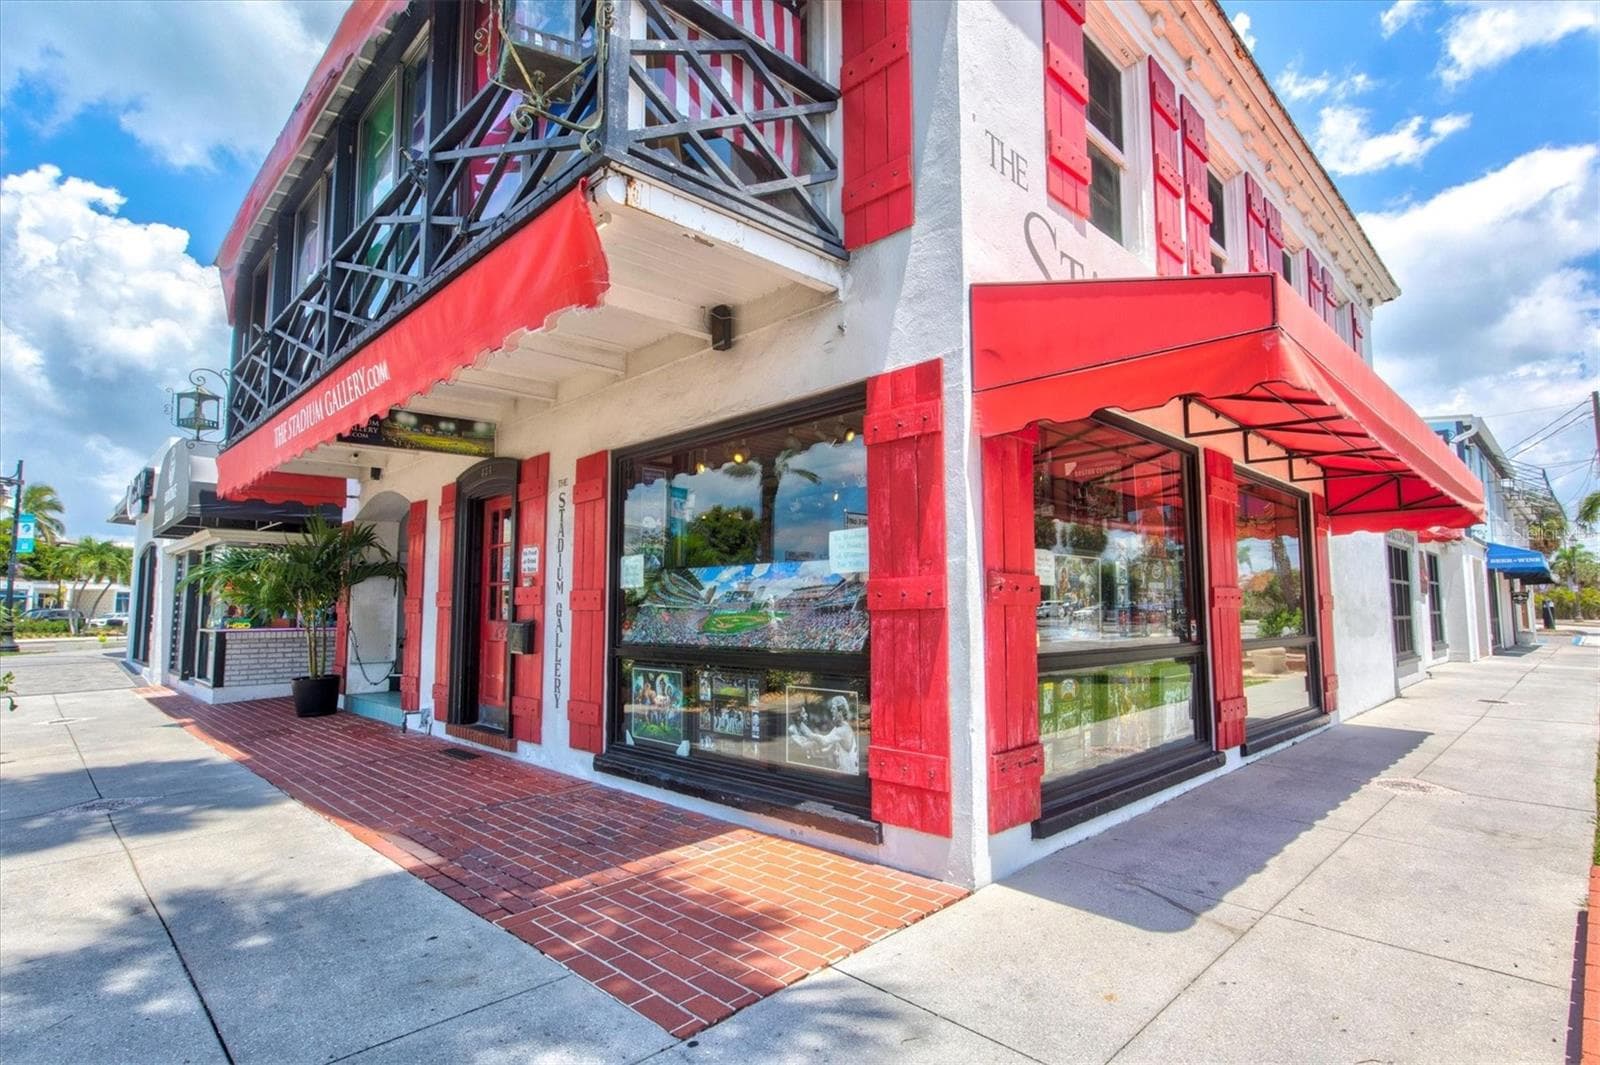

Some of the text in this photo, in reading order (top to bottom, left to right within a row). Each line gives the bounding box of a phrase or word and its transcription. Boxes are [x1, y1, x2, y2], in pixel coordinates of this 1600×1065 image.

[985, 129, 1029, 192] THE
[273, 421, 288, 448] THE
[287, 398, 325, 440] STADIUM
[557, 478, 568, 489] THE
[555, 492, 566, 595] STADIUM
[555, 602, 564, 709] GALLERY
